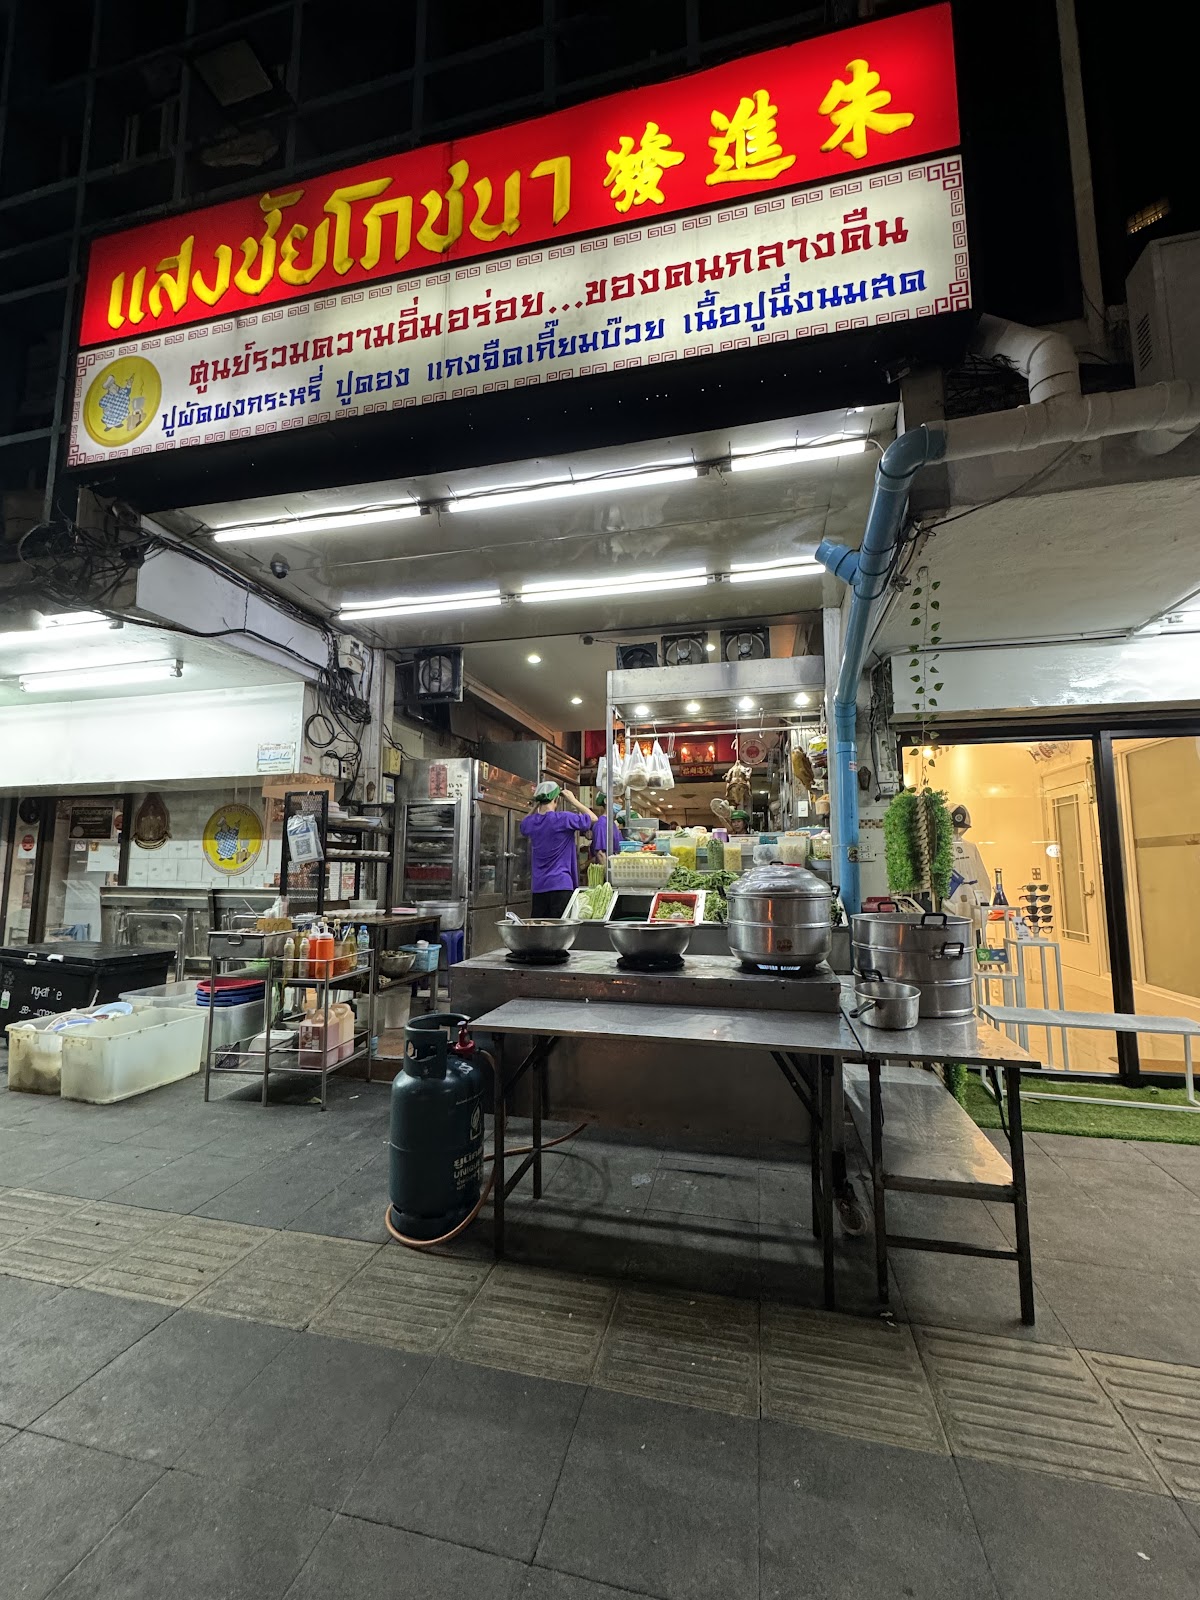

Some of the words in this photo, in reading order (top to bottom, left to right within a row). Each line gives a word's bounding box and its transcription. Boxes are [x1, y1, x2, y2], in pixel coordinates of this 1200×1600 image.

[107, 155, 571, 329] แสงชัยโภชนา
[161, 365, 324, 438] ปูผัดผงกระหรี่
[336, 368, 410, 406] ปูดอง
[684, 269, 926, 332] เนื้อปูนึ่งนมสด
